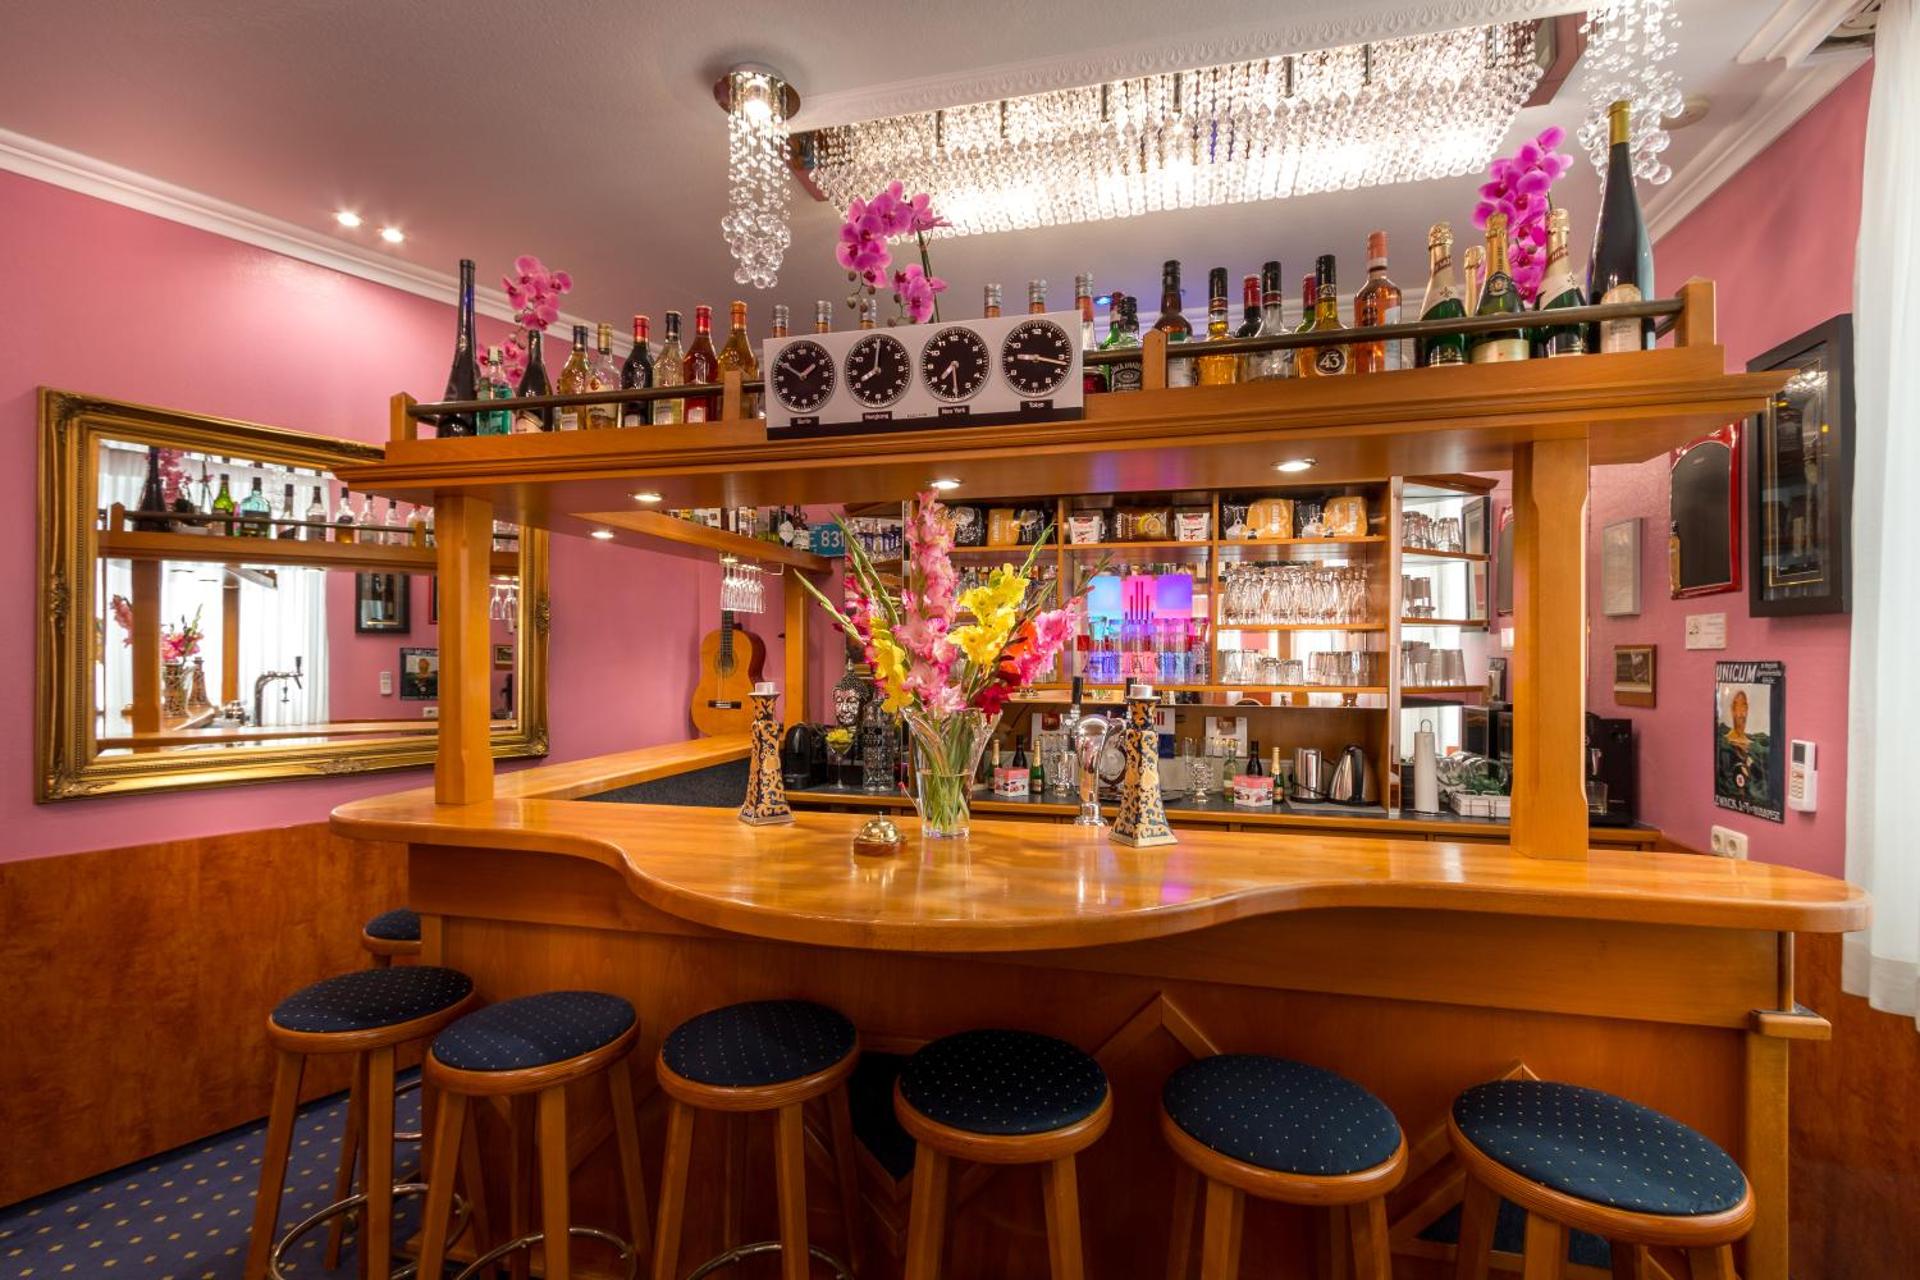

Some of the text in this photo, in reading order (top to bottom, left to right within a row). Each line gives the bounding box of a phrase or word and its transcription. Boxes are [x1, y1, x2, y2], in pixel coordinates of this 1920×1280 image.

[1320, 353, 1341, 368] 43
[821, 530, 845, 548] 831
[1716, 663, 1757, 683] UNICUM
